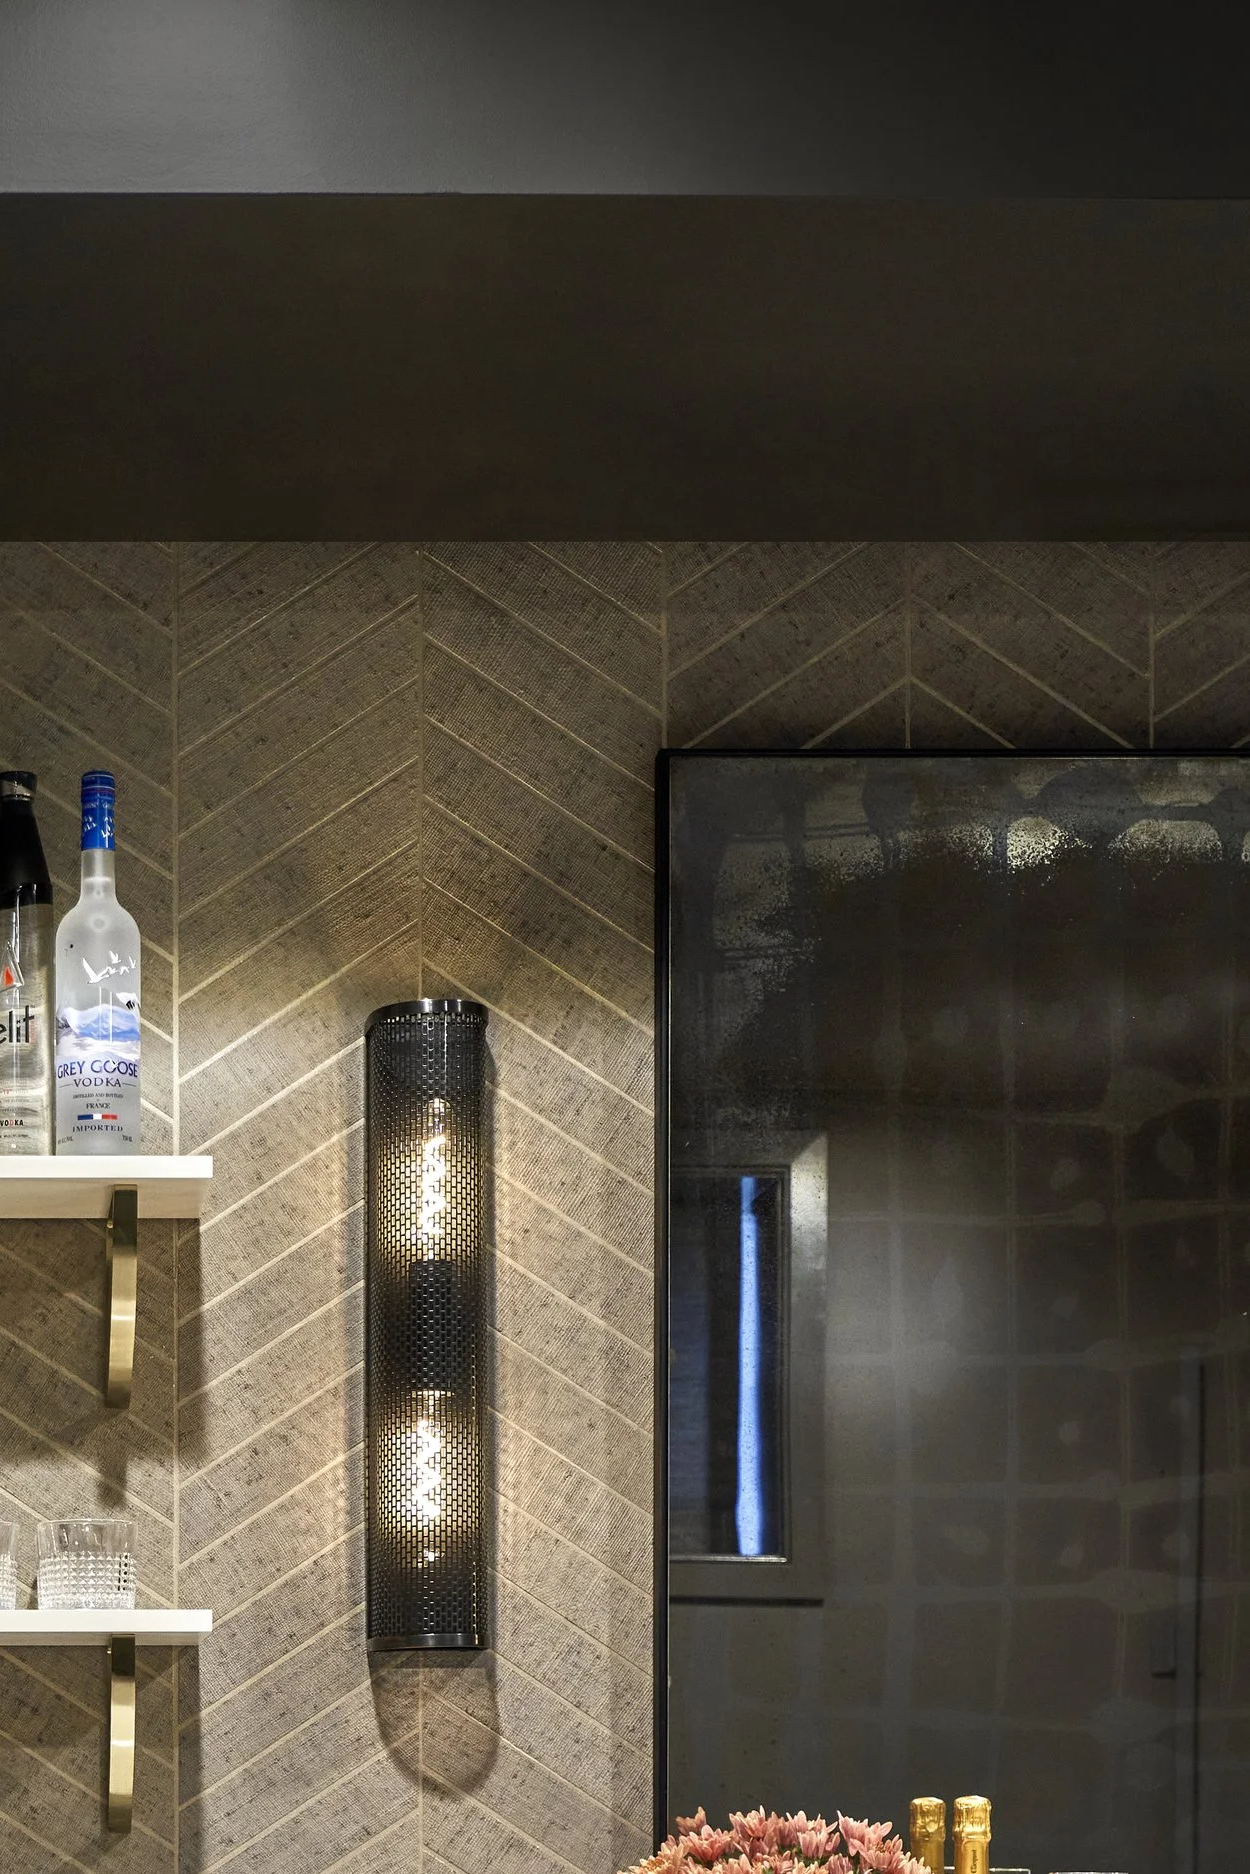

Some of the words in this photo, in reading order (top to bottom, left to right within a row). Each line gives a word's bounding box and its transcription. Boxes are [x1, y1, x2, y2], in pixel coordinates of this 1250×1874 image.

[57, 1060, 85, 1079] GREY
[90, 1059, 138, 1078] GOOSE
[73, 1077, 122, 1088] VODKA
[0, 1119, 24, 1127] VODKA
[72, 1124, 124, 1133] IMPORTED
